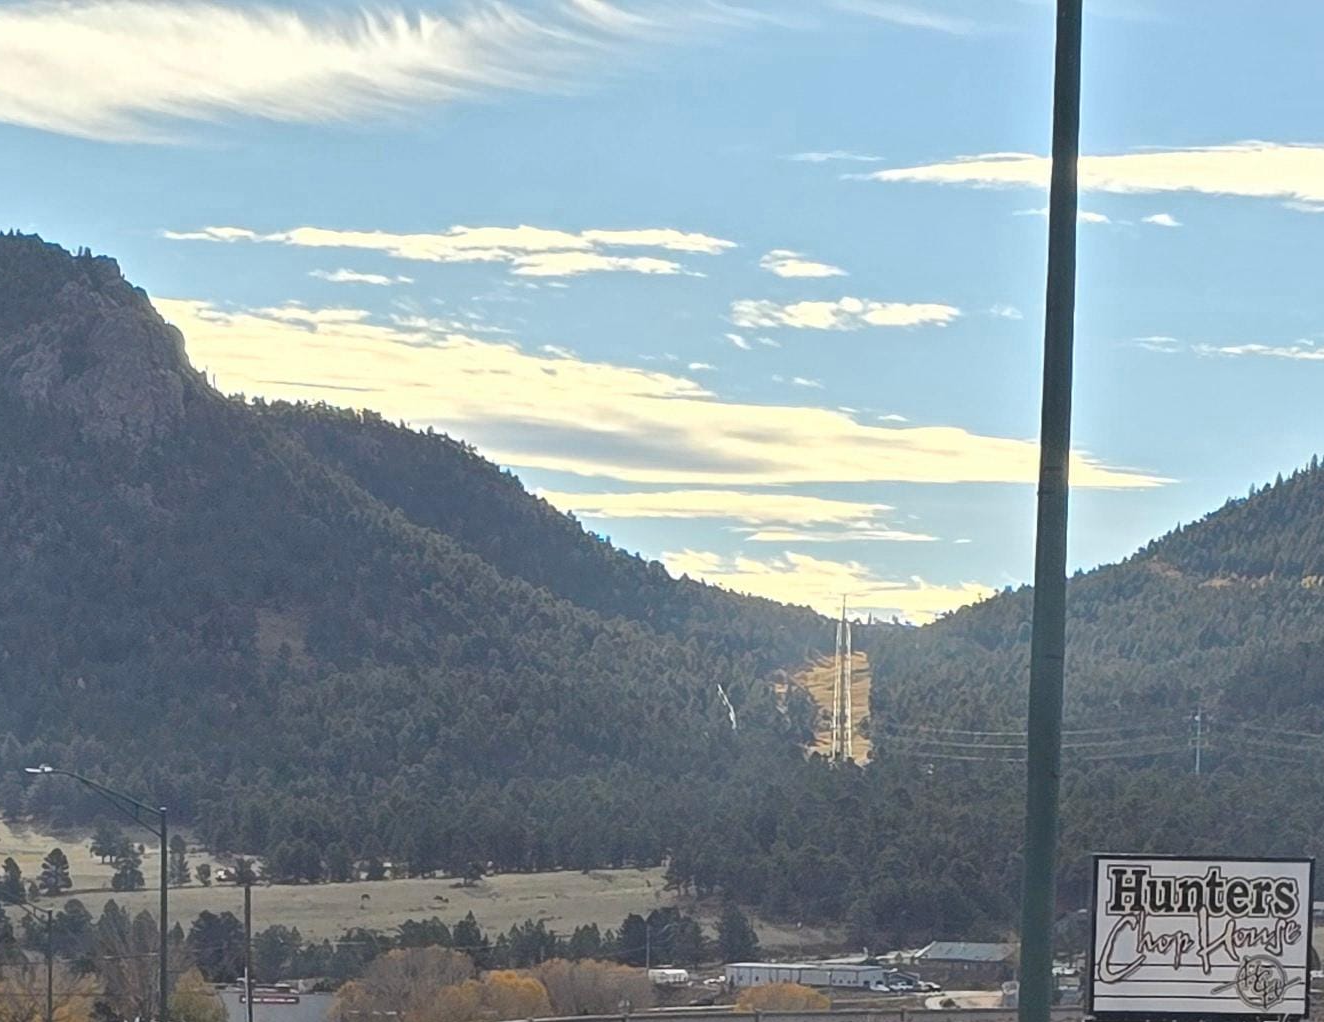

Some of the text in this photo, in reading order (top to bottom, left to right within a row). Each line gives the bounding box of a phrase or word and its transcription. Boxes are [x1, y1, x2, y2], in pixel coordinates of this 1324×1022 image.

[1107, 866, 1298, 917] Hunters
[1098, 904, 1302, 984] Chop House
